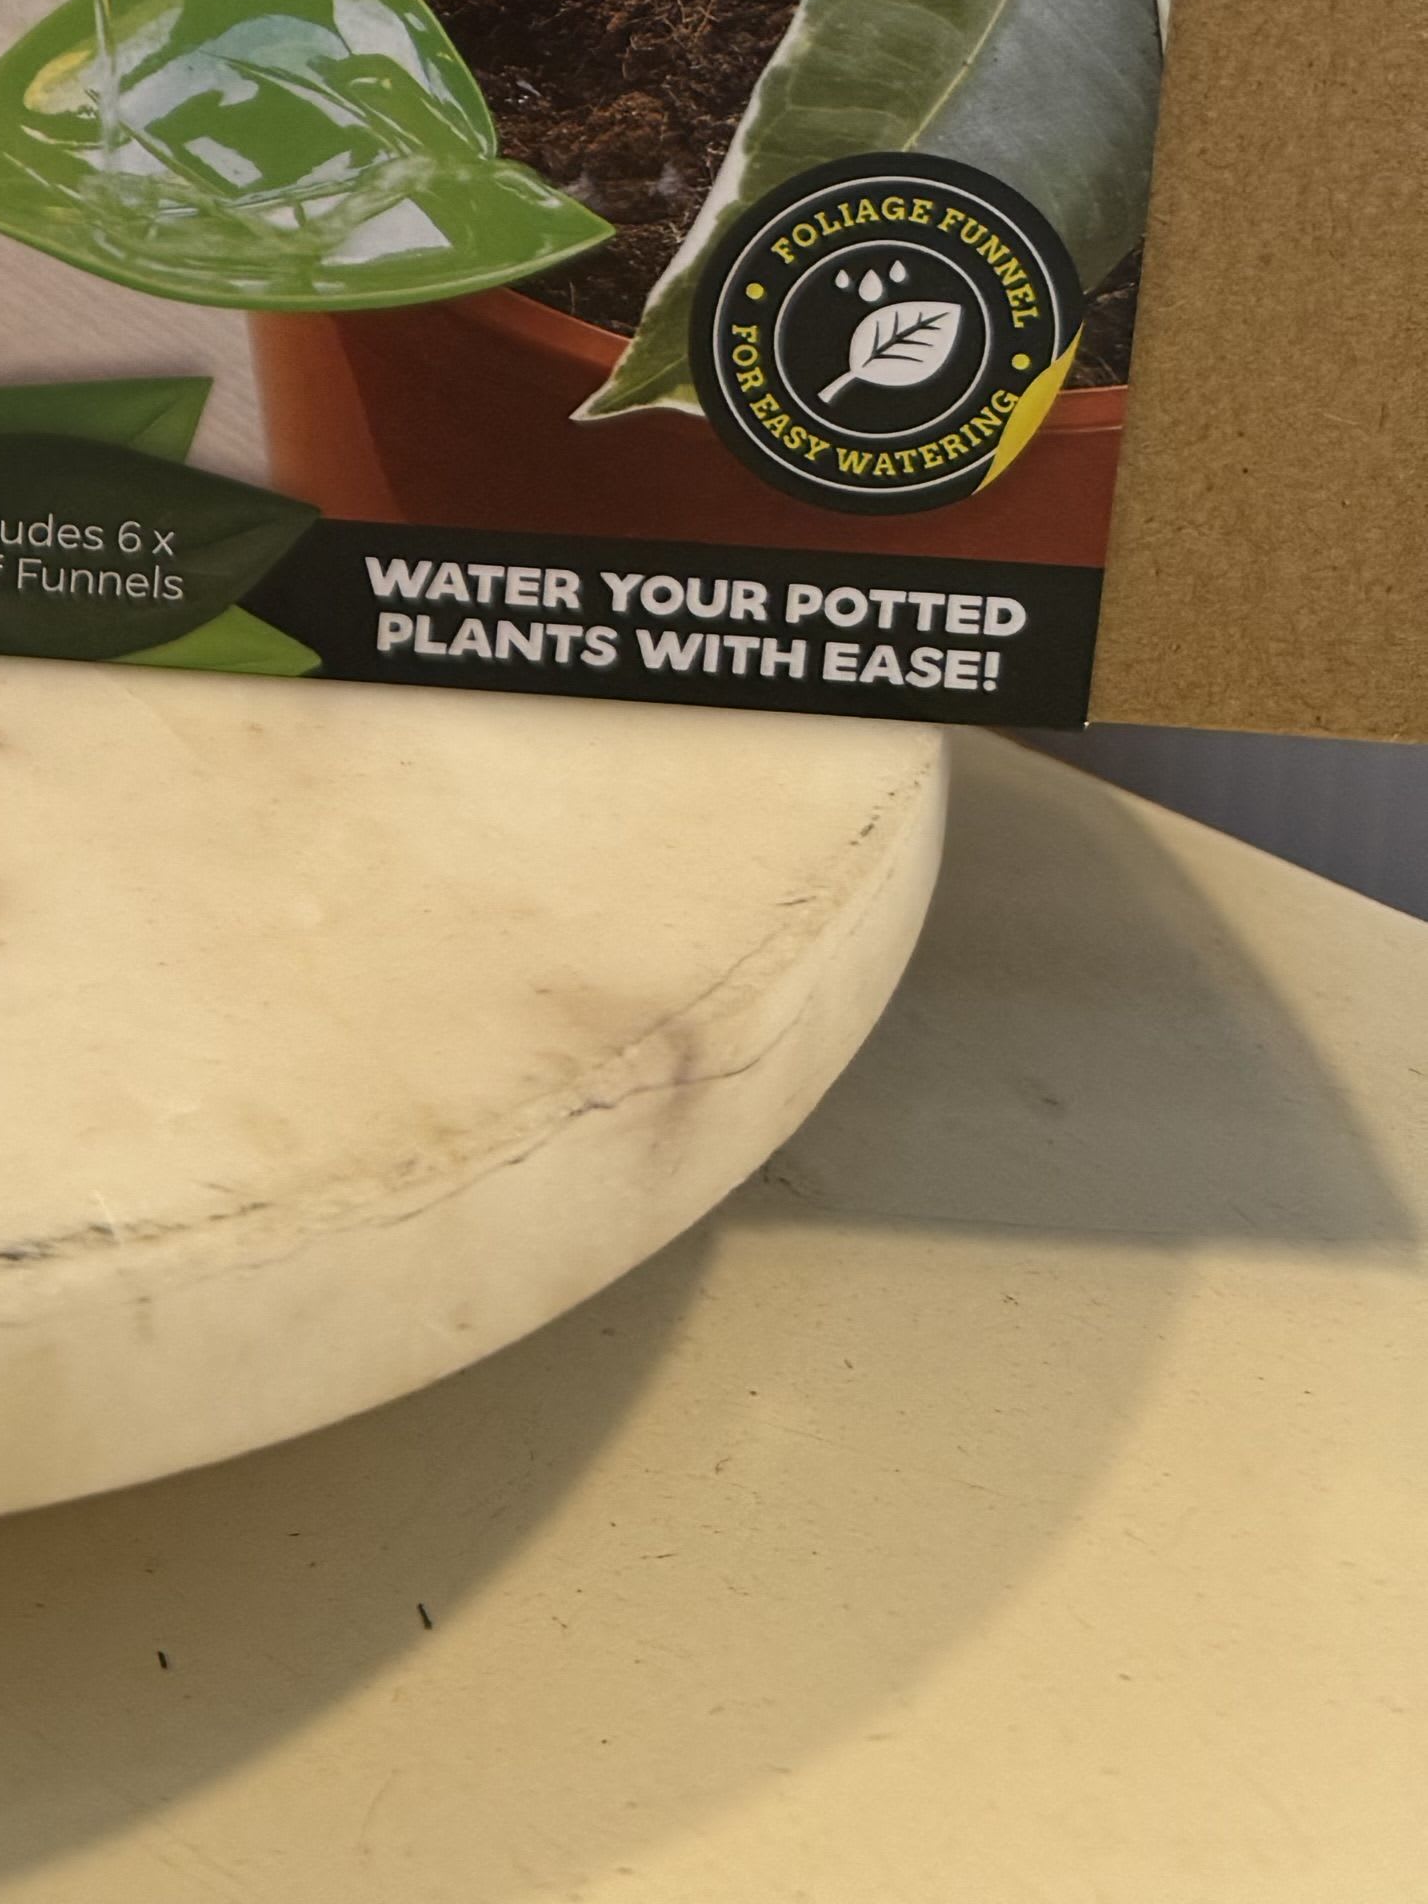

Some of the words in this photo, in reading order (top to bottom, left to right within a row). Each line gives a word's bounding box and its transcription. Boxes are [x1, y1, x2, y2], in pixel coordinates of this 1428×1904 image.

[770, 196, 935, 265] FOLIAGE
[937, 206, 1039, 329] FUNNEL
[731, 323, 764, 393] FOR
[748, 392, 831, 462] EASY
[835, 388, 1021, 476] WATERING
[16, 557, 185, 600] Funnels
[117, 520, 143, 554] 6
[151, 529, 175, 557] x
[364, 555, 581, 610] WATER
[599, 570, 768, 622] YOUR
[784, 582, 1027, 637] POTTED
[376, 611, 618, 667] PLANTS
[635, 628, 808, 679] WITH
[822, 640, 1001, 692] EASE!
